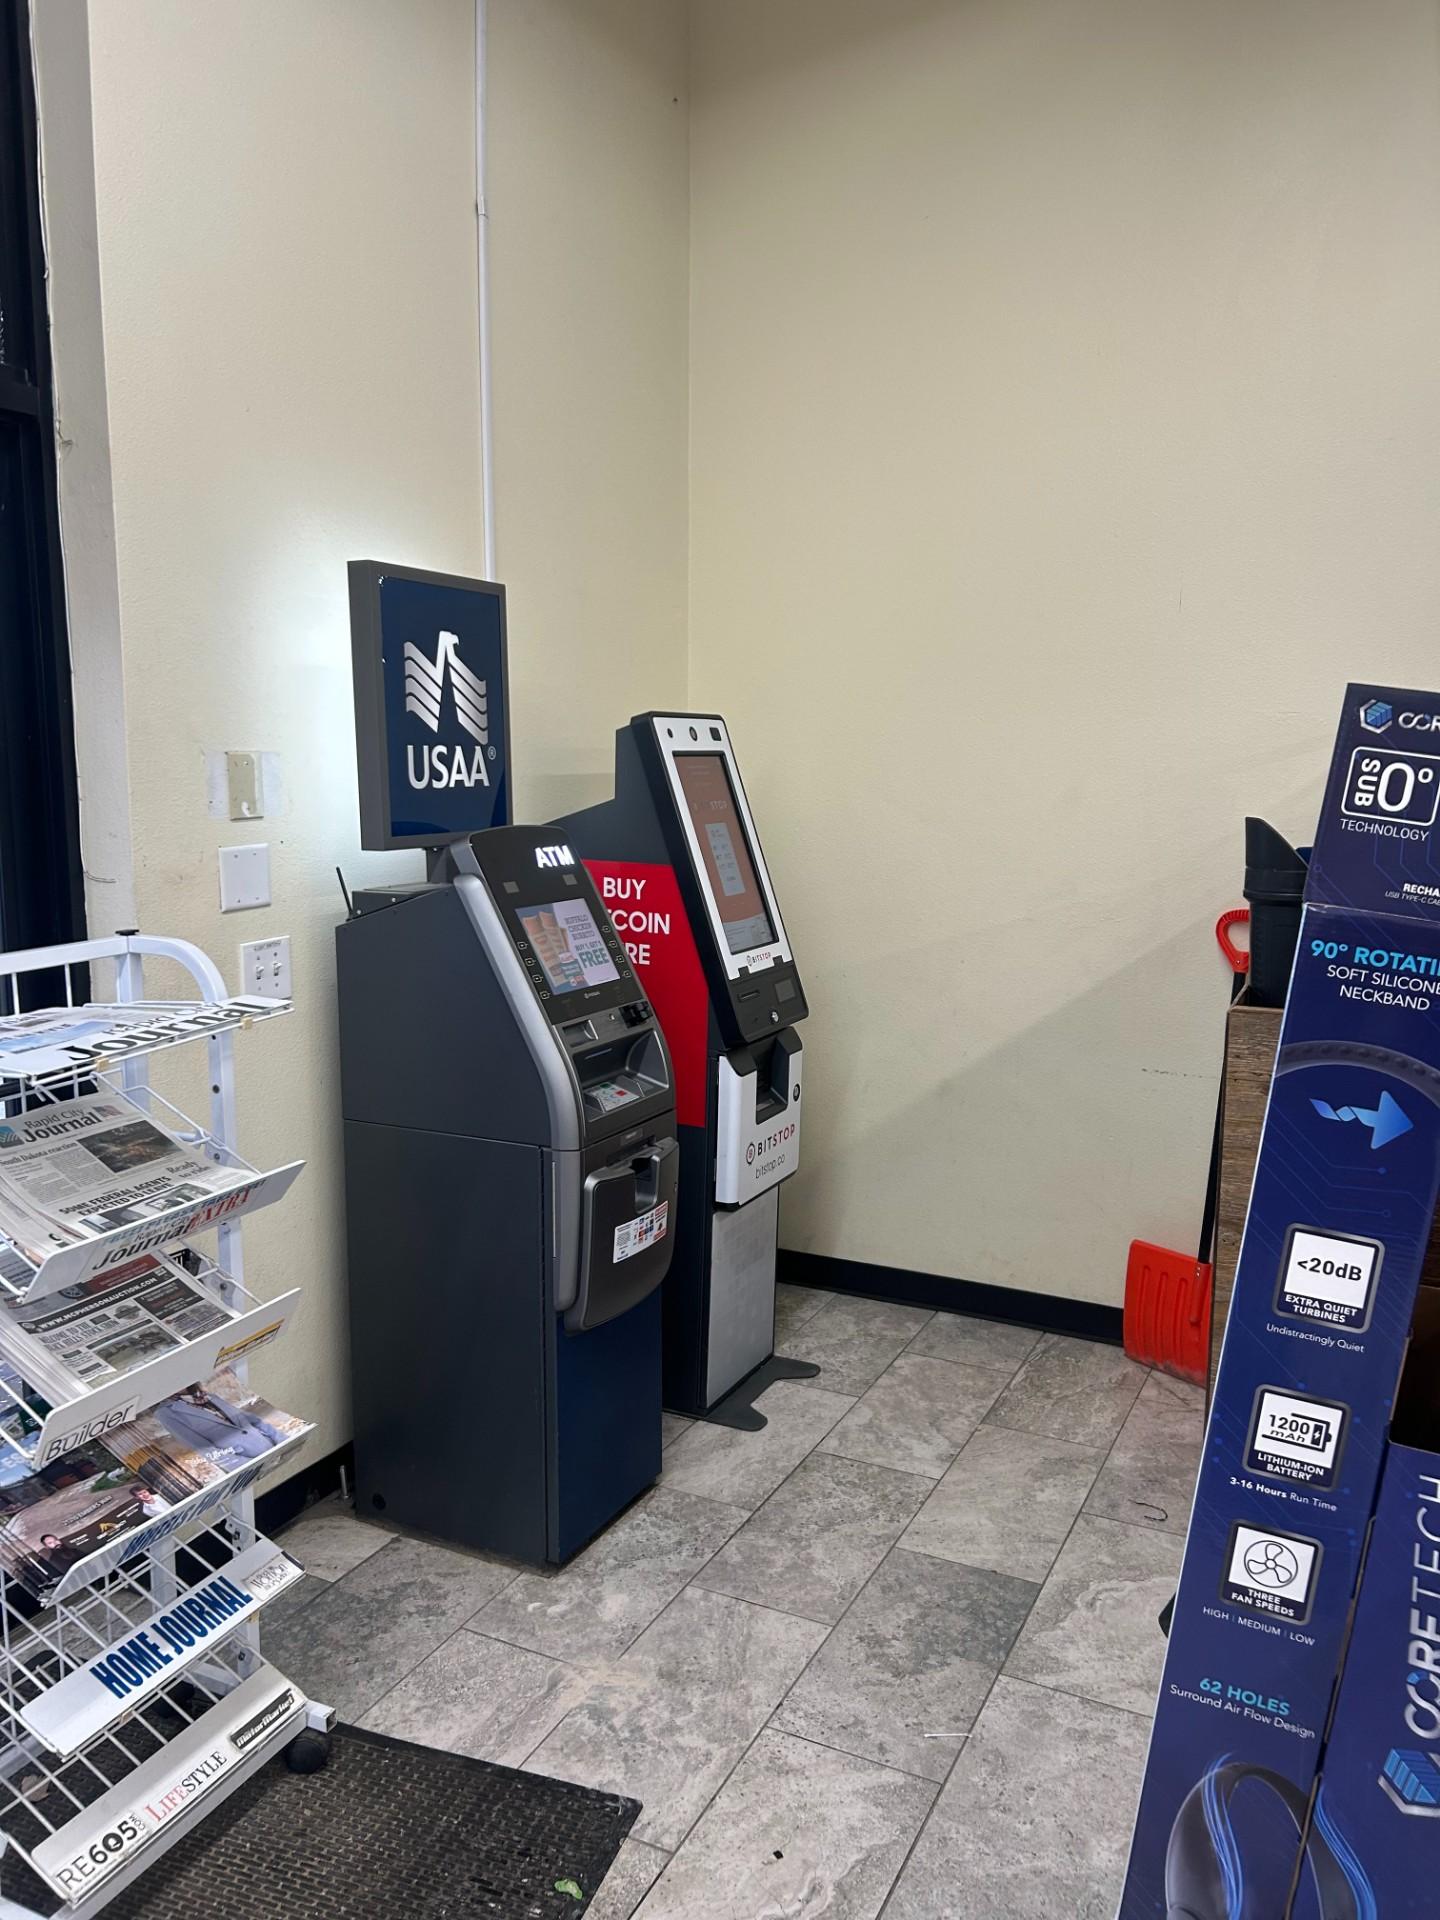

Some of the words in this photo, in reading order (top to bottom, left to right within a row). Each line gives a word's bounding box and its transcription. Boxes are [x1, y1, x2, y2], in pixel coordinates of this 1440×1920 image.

[407, 745, 490, 789] USAA
[1354, 758, 1381, 807] SUB
[1340, 818, 1429, 842] TECHNOLOGY
[535, 845, 575, 868] ATM
[603, 877, 646, 900] BUY
[1385, 890, 1400, 899] USB
[1402, 893, 1427, 904] TYPE-C
[608, 910, 671, 934] COIN
[579, 948, 609, 969] FREE
[625, 943, 651, 966] RE
[752, 952, 771, 963] BITSTOP
[1354, 946, 1440, 976] ROTATI
[1327, 965, 1369, 983] SOFT
[1340, 985, 1430, 1011] NECKBAND
[59, 1001, 271, 1061] Journal
[22, 1111, 103, 1143] Journal
[24, 1113, 62, 1129] Rapid
[61, 1109, 86, 1119] City
[757, 1123, 795, 1156] BITSTOP
[755, 1154, 785, 1179] bitstop.co
[59, 1201, 92, 1215] SOME
[88, 1188, 135, 1204] FEDERAL
[133, 1175, 172, 1192] AGENTS
[77, 1197, 130, 1216] EXPECTED
[127, 1192, 142, 1200] TO
[141, 1182, 174, 1196] LEAVE
[92, 1217, 194, 1270] Journal
[1297, 1257, 1362, 1281] <20dB
[1285, 1294, 1320, 1309] EXTRA
[1324, 1303, 1358, 1317] QUIET
[1293, 1305, 1346, 1323] TURBINES
[1266, 1323, 1335, 1347] Undistractingly
[1337, 1339, 1365, 1353] Quiet
[46, 1404, 135, 1462] Builder
[1269, 1414, 1310, 1435] 1200
[1270, 1429, 1305, 1443] mAh
[1257, 1452, 1324, 1476] LITHIUM-ION
[1266, 1464, 1312, 1481] BATTERY
[1230, 1477, 1253, 1490] 3-16
[1256, 1484, 1287, 1498] Hours
[1290, 1493, 1309, 1504] Run
[1312, 1498, 1337, 1512] Time
[1231, 1592, 1253, 1604] FAN
[1255, 1600, 1295, 1617] SPEEDS
[1247, 1588, 1281, 1605] THREE
[89, 1631, 174, 1699] HOME
[152, 1575, 254, 1656] JOURNAL
[1203, 1606, 1229, 1620] HIGH
[1237, 1617, 1281, 1636] MEDIUM
[1289, 1631, 1316, 1646] LOW
[1199, 1677, 1222, 1695] 62
[1226, 1685, 1291, 1716] HOLES
[1170, 1684, 1222, 1709] Surround
[1224, 1700, 1241, 1715] Air
[1244, 1707, 1272, 1725] Flow
[1273, 1716, 1316, 1740] Design
